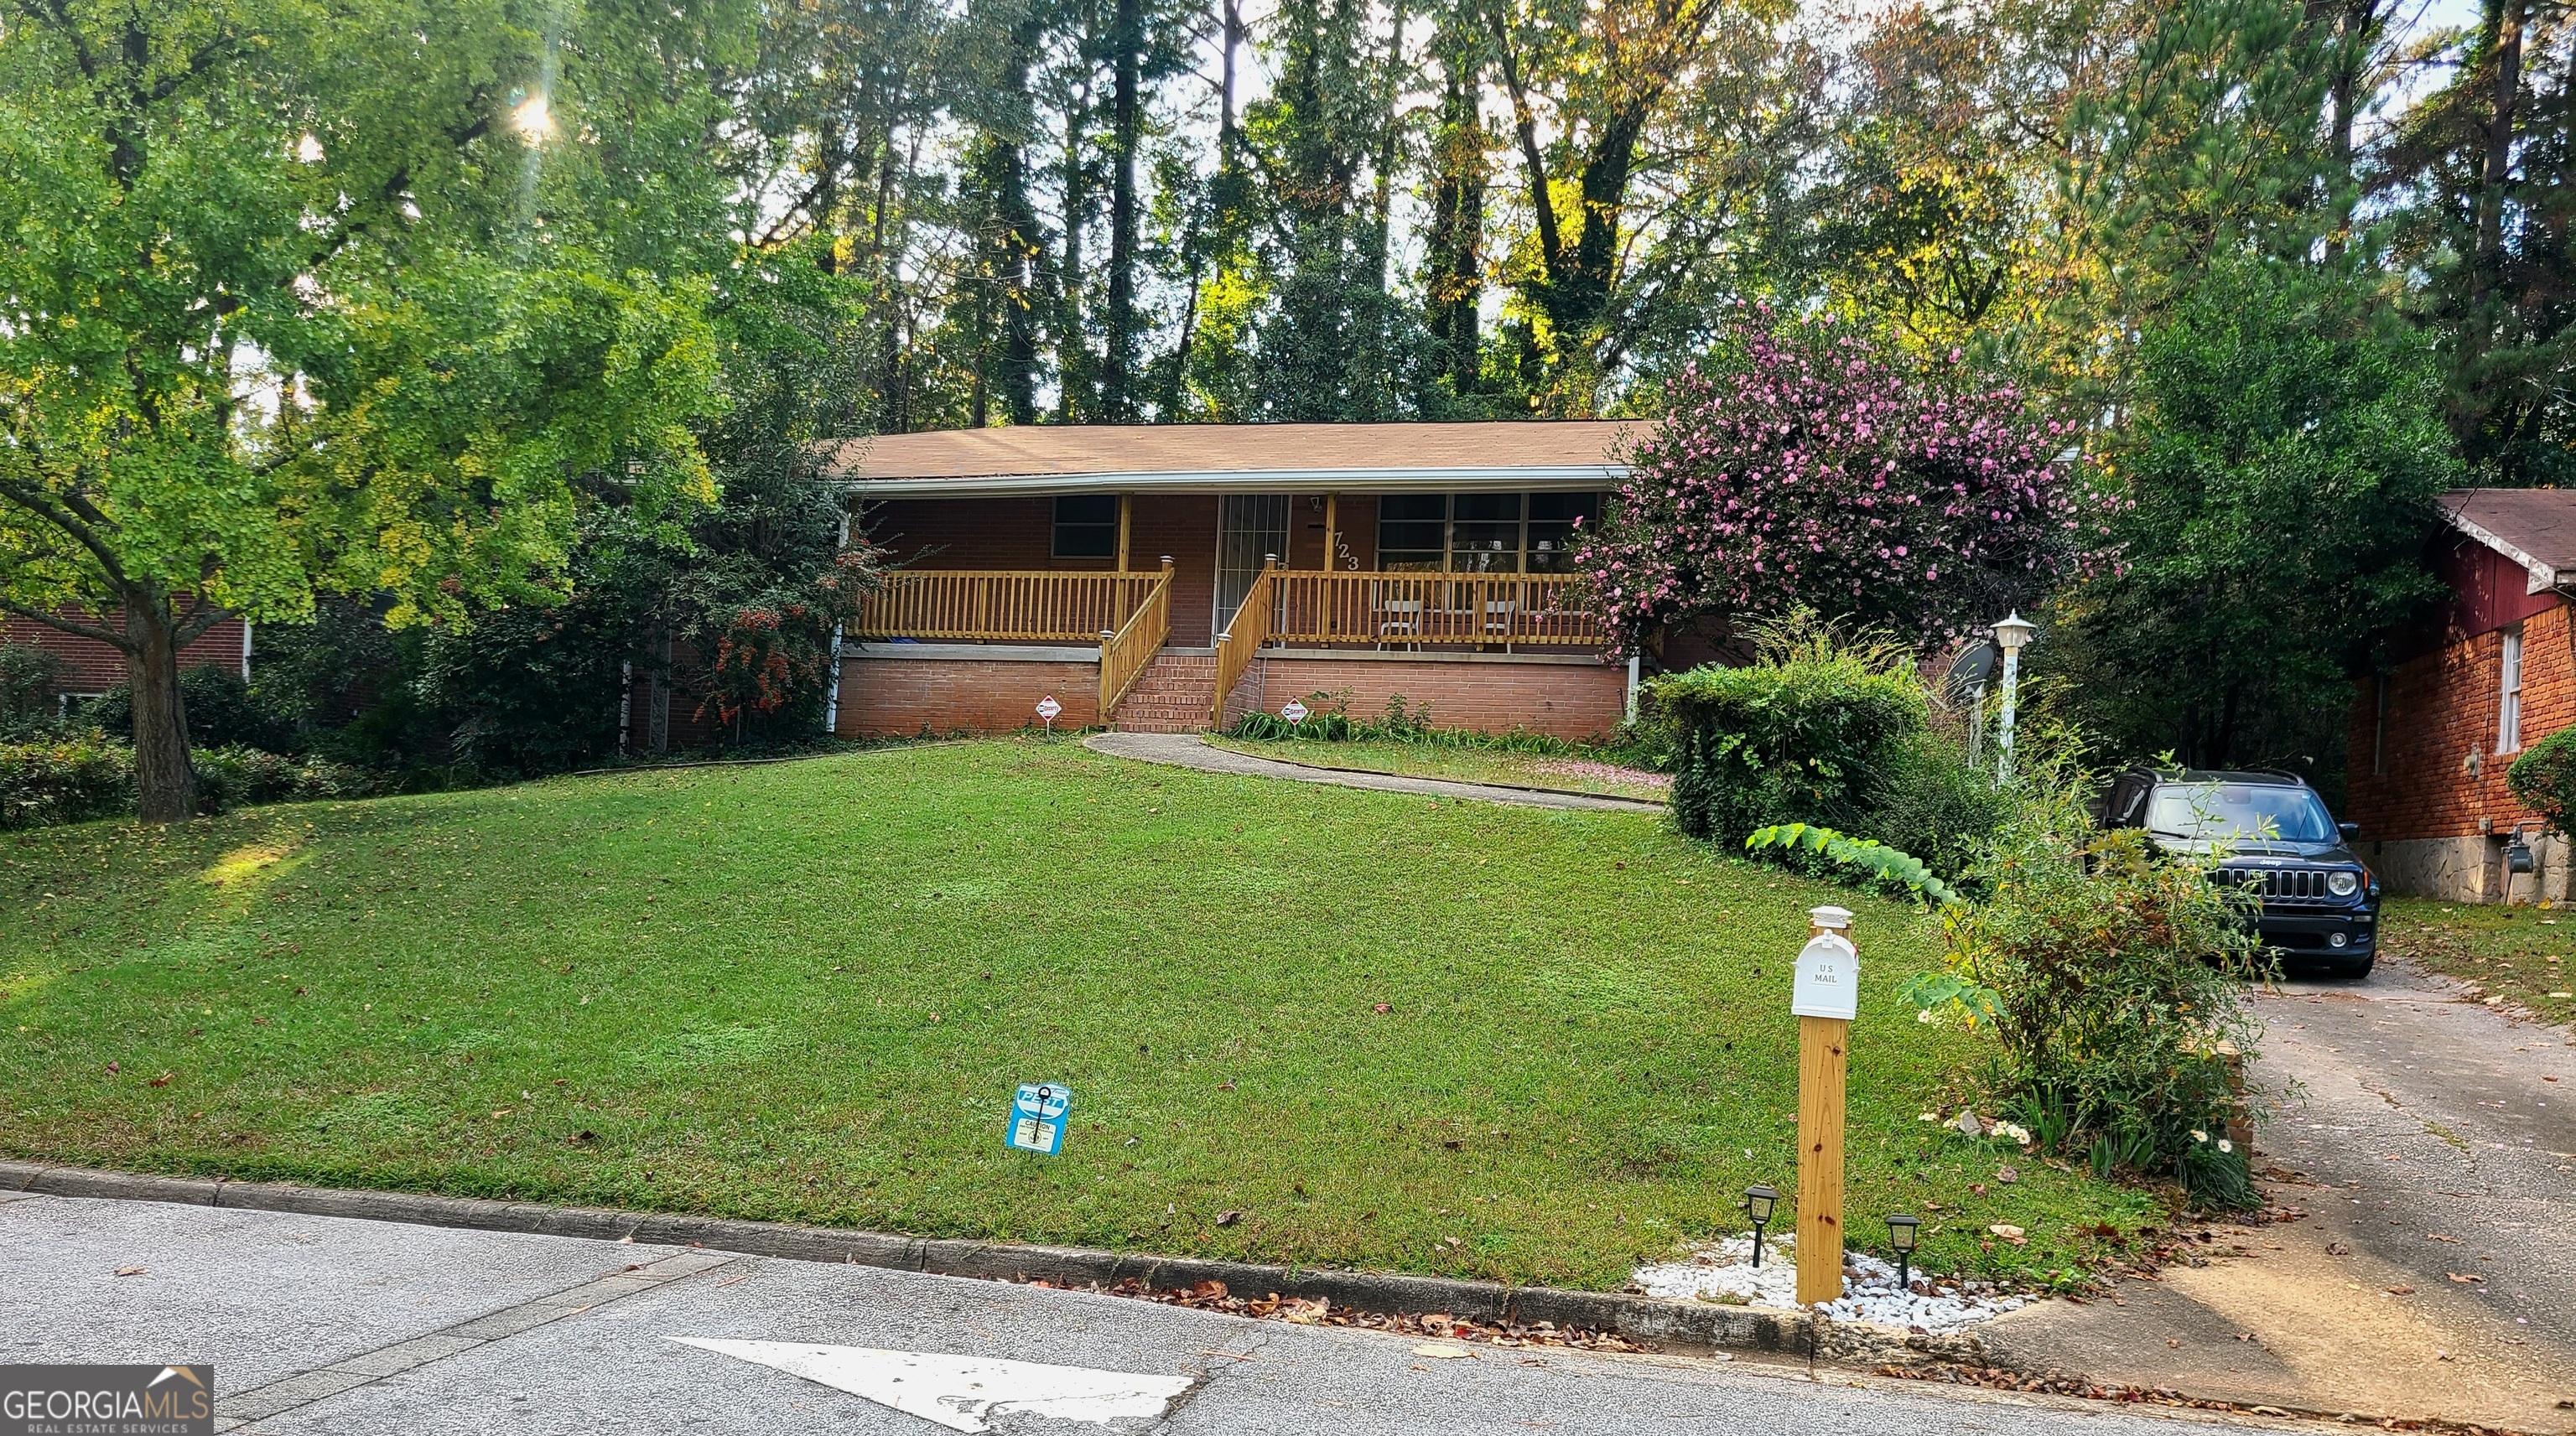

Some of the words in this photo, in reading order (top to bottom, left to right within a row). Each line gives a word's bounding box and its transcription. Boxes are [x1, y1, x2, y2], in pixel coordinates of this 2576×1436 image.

[1334, 531, 1359, 570] 723
[1815, 974, 1837, 983] MAIL
[1021, 1091, 1062, 1107] PEST
